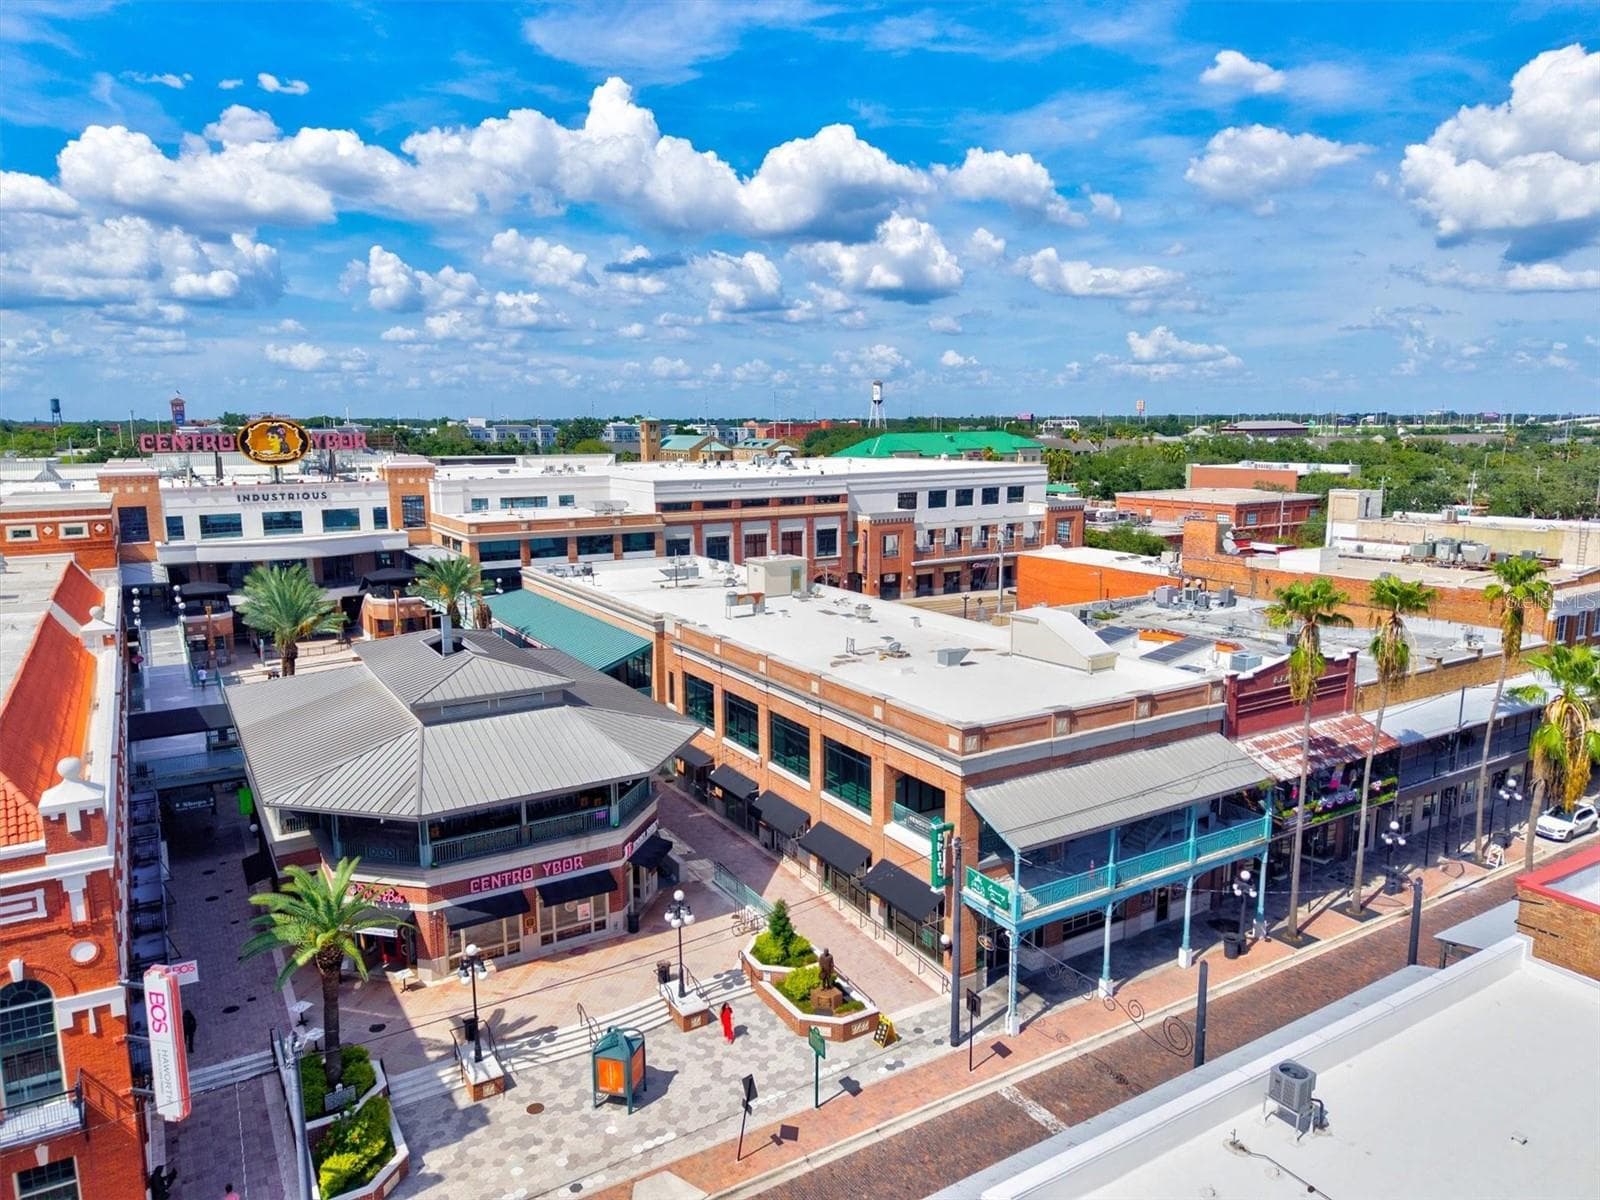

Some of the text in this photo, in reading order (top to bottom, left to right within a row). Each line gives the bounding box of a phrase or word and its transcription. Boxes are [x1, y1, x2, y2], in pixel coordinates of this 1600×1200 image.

[140, 431, 367, 452] CENTRO YBOR
[237, 491, 328, 503] INDUSTRIOUS
[470, 856, 584, 893] CENTRO YBOR
[149, 991, 168, 1034] BOS
[161, 1049, 174, 1105] HAWORTH
